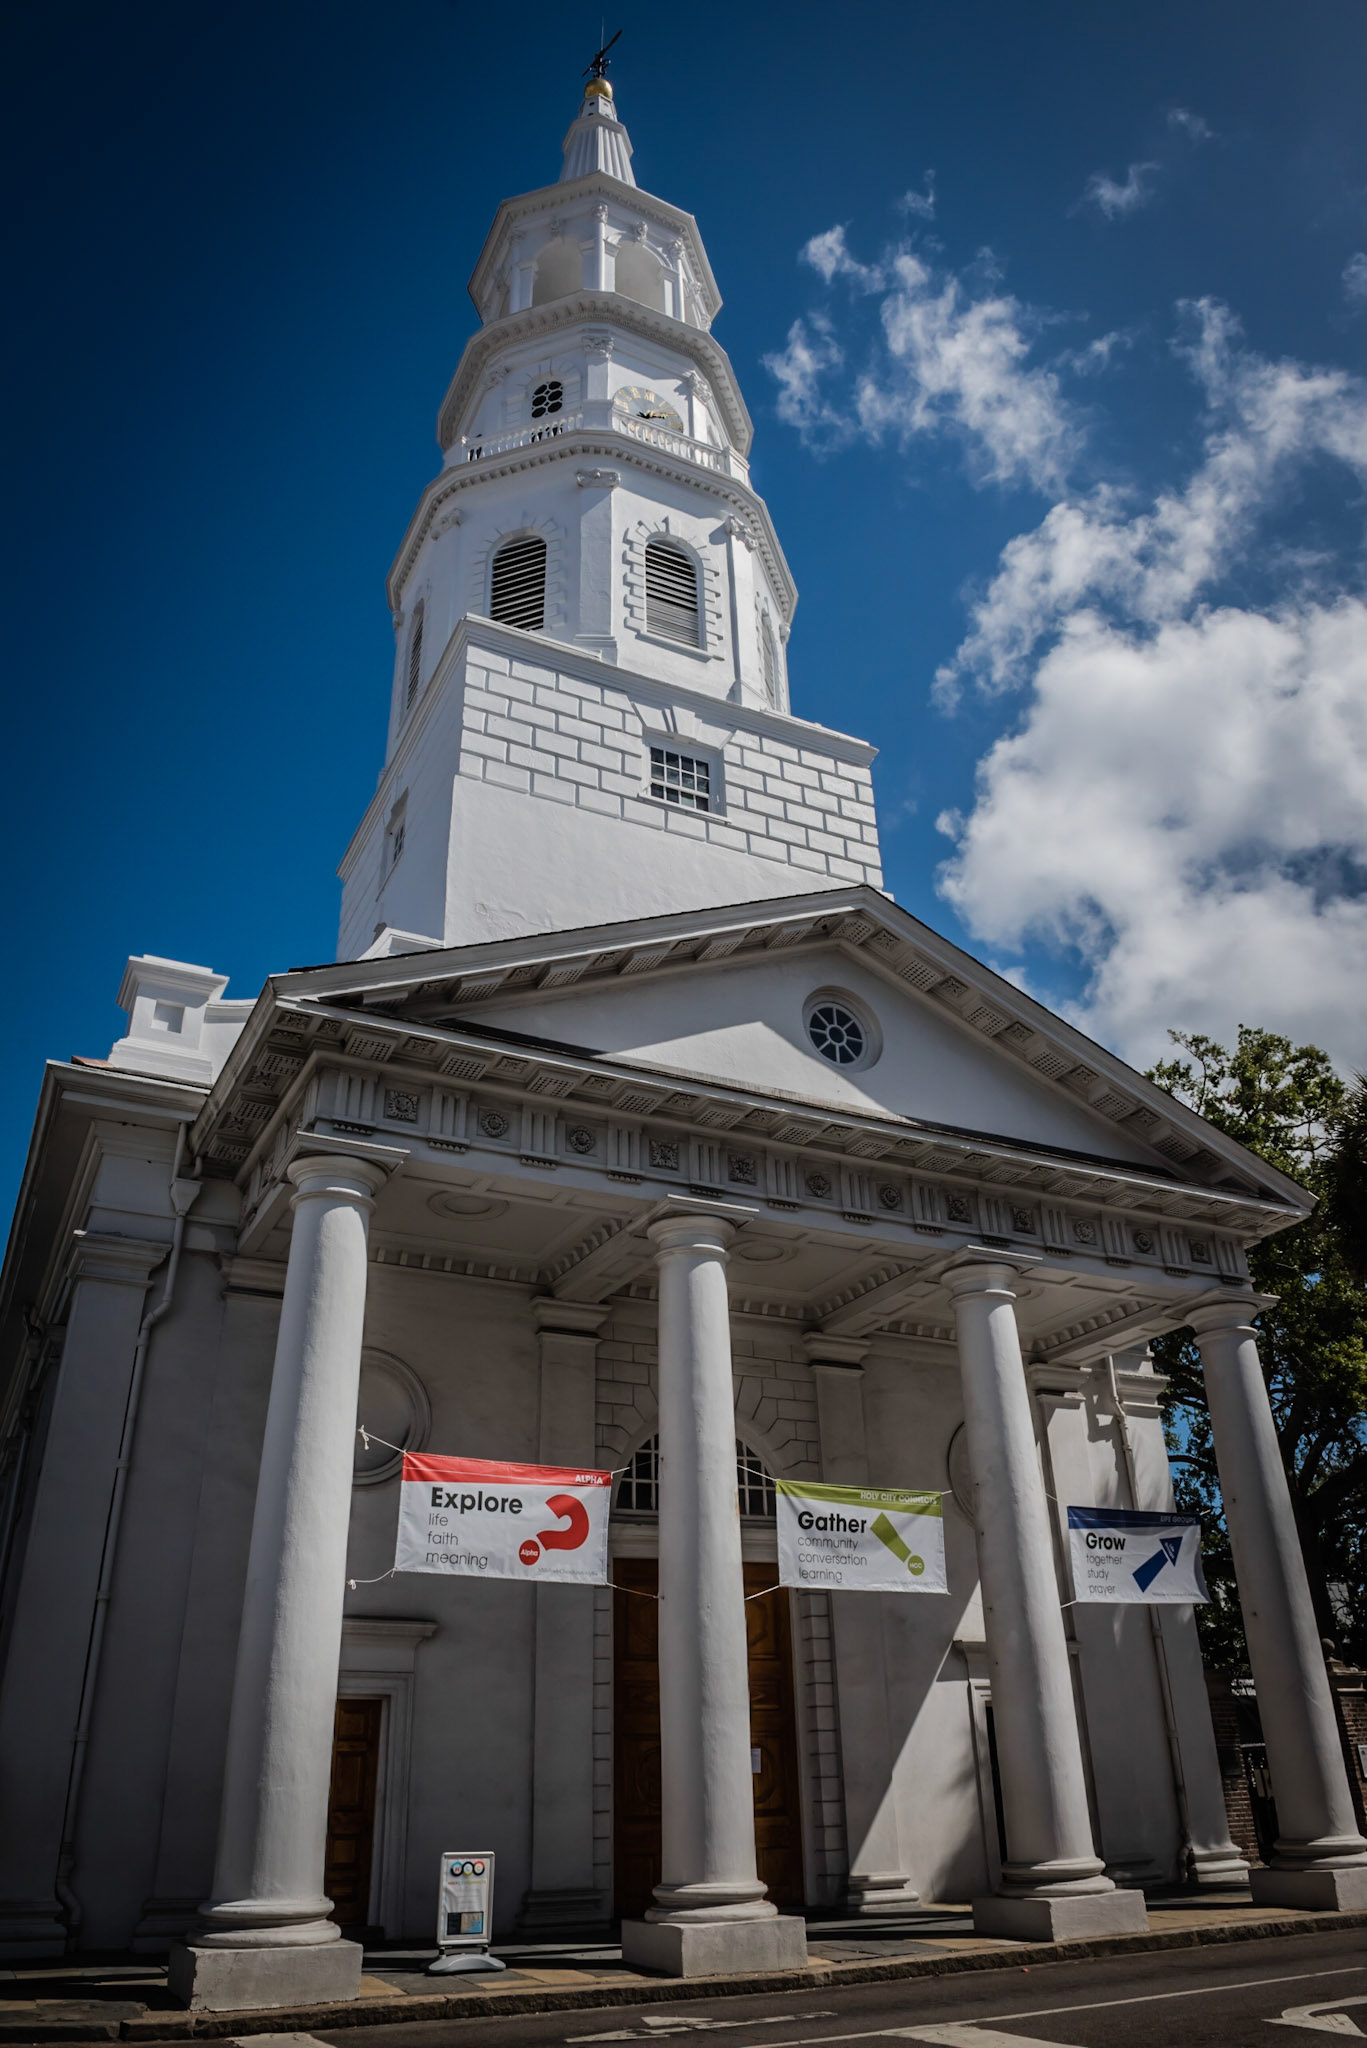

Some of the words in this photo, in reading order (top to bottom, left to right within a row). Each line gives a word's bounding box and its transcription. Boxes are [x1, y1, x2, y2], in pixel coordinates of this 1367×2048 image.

[575, 1474, 603, 1485] ALPHA
[431, 1486, 523, 1514] Explore
[860, 1491, 880, 1501] HOLY
[881, 1493, 897, 1502] CITY
[898, 1495, 938, 1505] CONNECTS
[428, 1512, 449, 1527] life
[798, 1511, 867, 1533] Gather
[427, 1530, 459, 1546] faith
[798, 1536, 859, 1551] community
[1085, 1532, 1126, 1550] Grow
[519, 1548, 539, 1558] Alpha
[798, 1552, 867, 1566] conversation
[1086, 1554, 1122, 1566] together
[426, 1552, 488, 1570] meaning
[798, 1567, 843, 1583] learning
[1087, 1568, 1109, 1580] study
[1088, 1583, 1116, 1597] prayer
